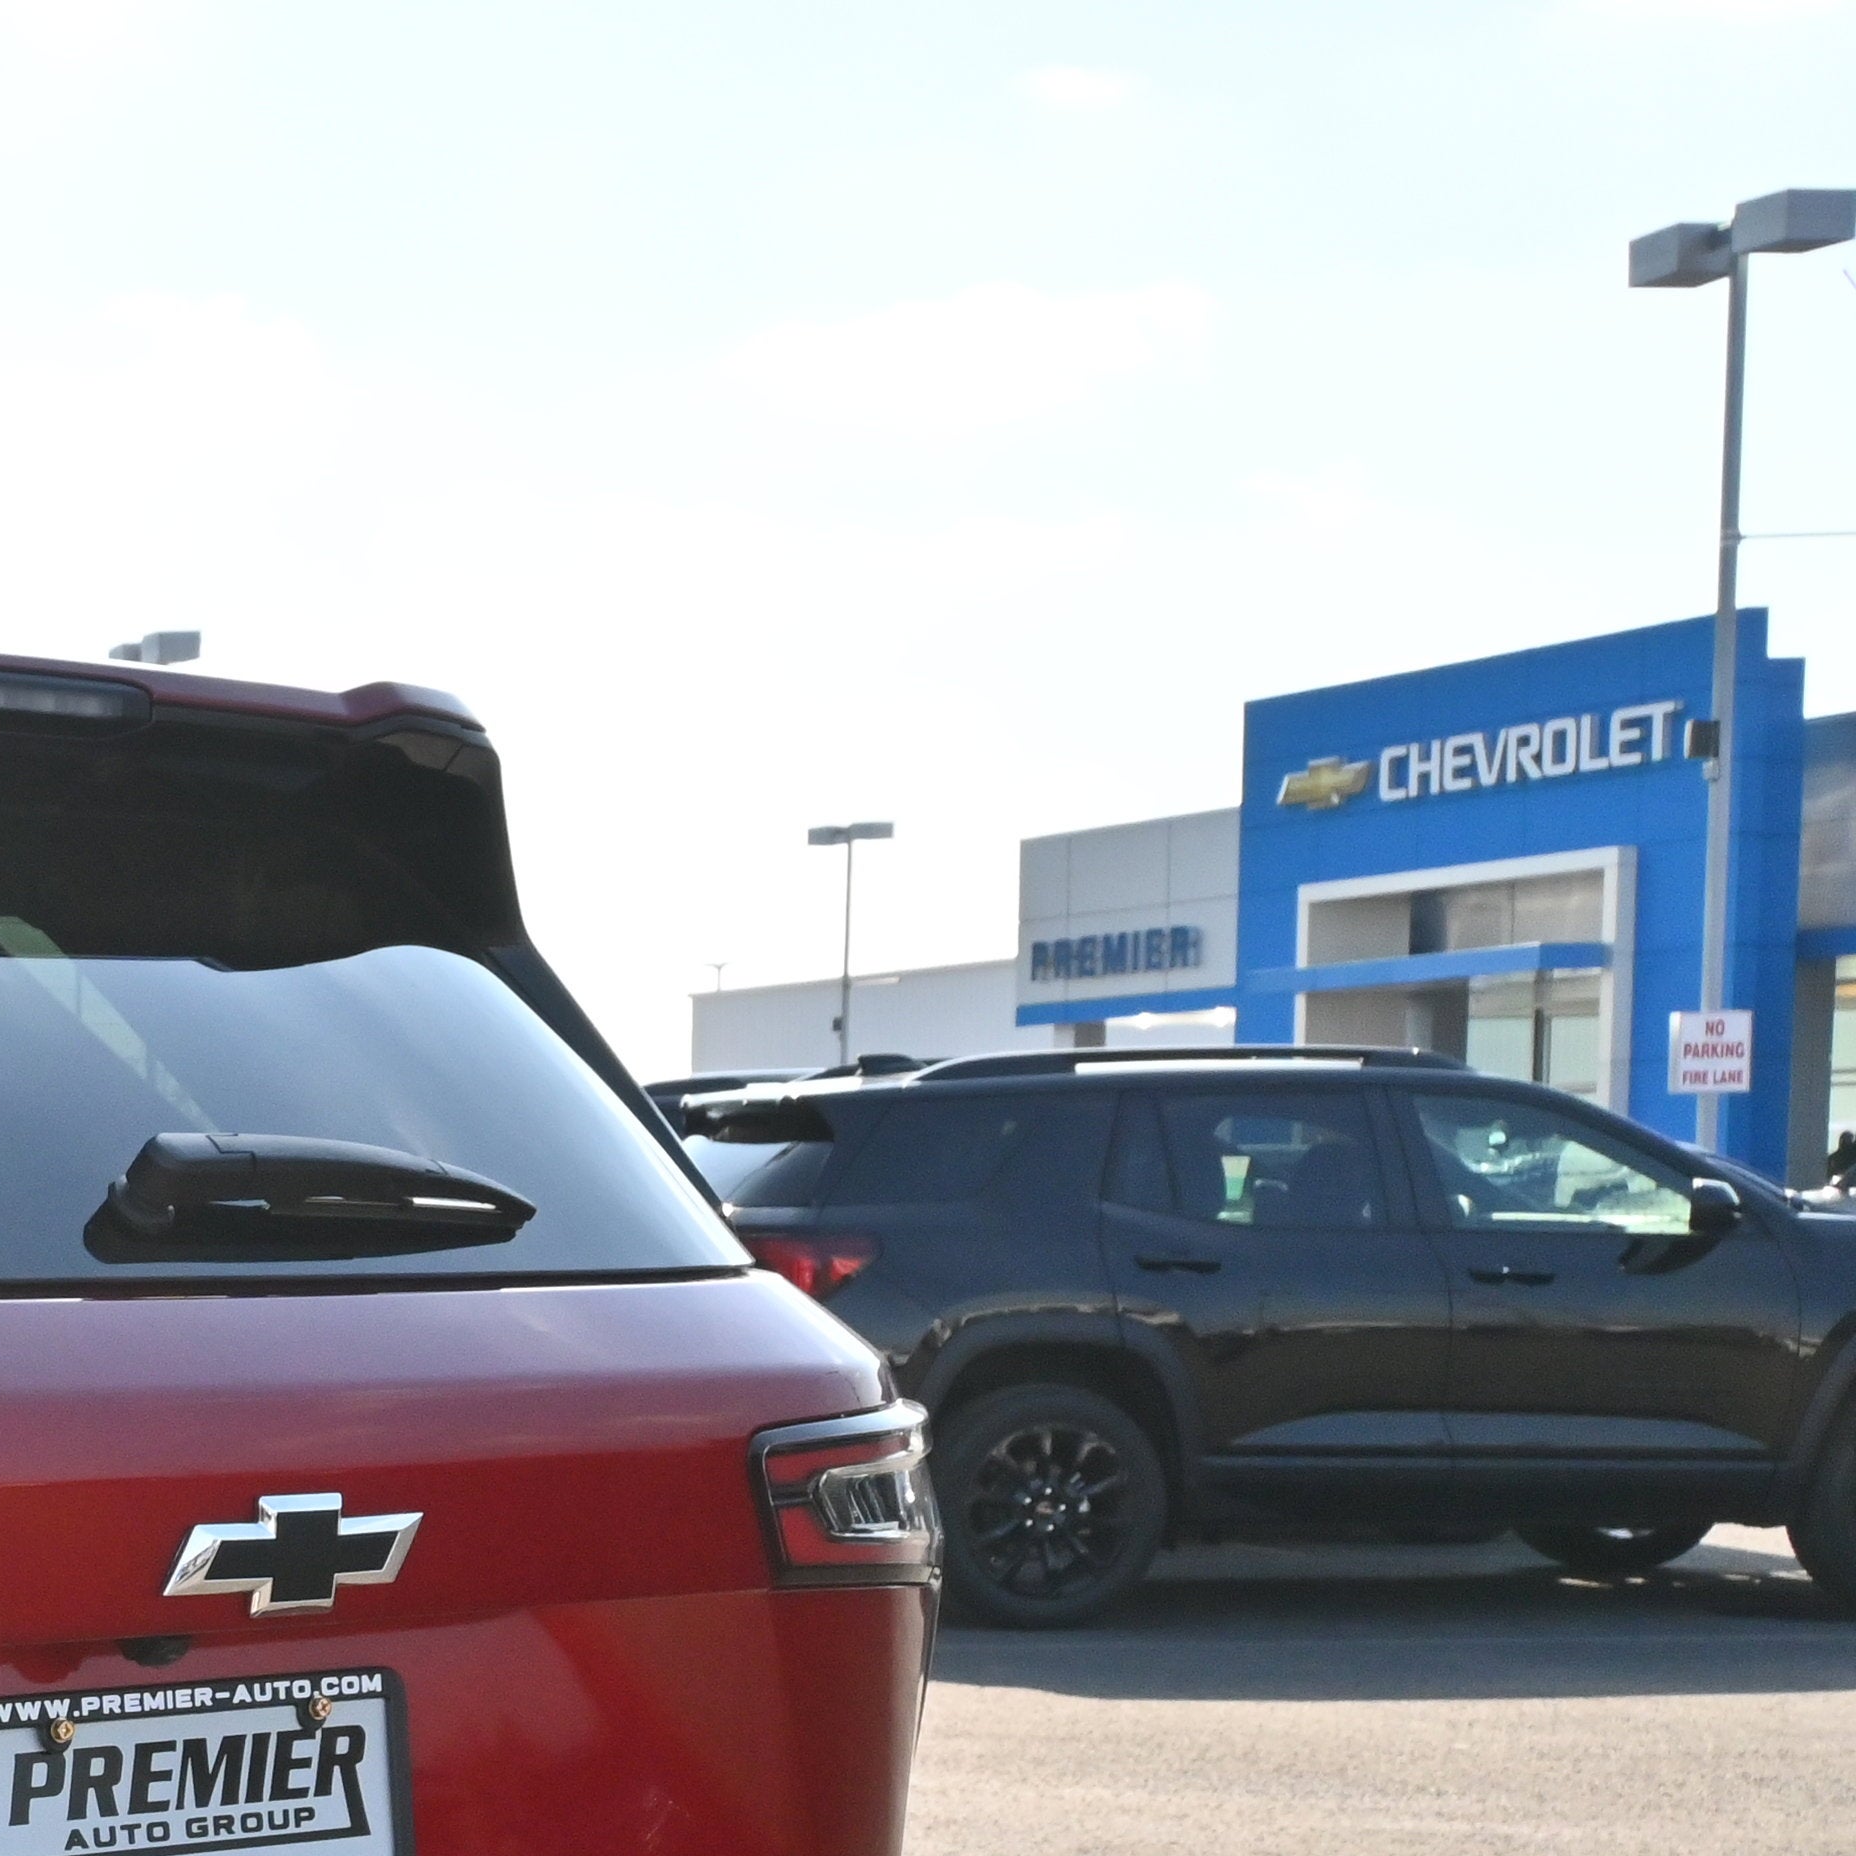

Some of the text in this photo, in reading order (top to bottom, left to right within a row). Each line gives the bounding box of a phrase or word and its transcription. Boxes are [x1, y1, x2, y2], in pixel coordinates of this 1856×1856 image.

[1379, 700, 1679, 801] CHEVROLET
[1031, 925, 1203, 981] PREMIER
[1705, 1019, 1725, 1036] NO
[1683, 1042, 1745, 1059] PARKING
[1682, 1069, 1743, 1085] FIRE LANE
[8, 1724, 371, 1836] PREMIER
[64, 1806, 316, 1851] AUTO GROUP
